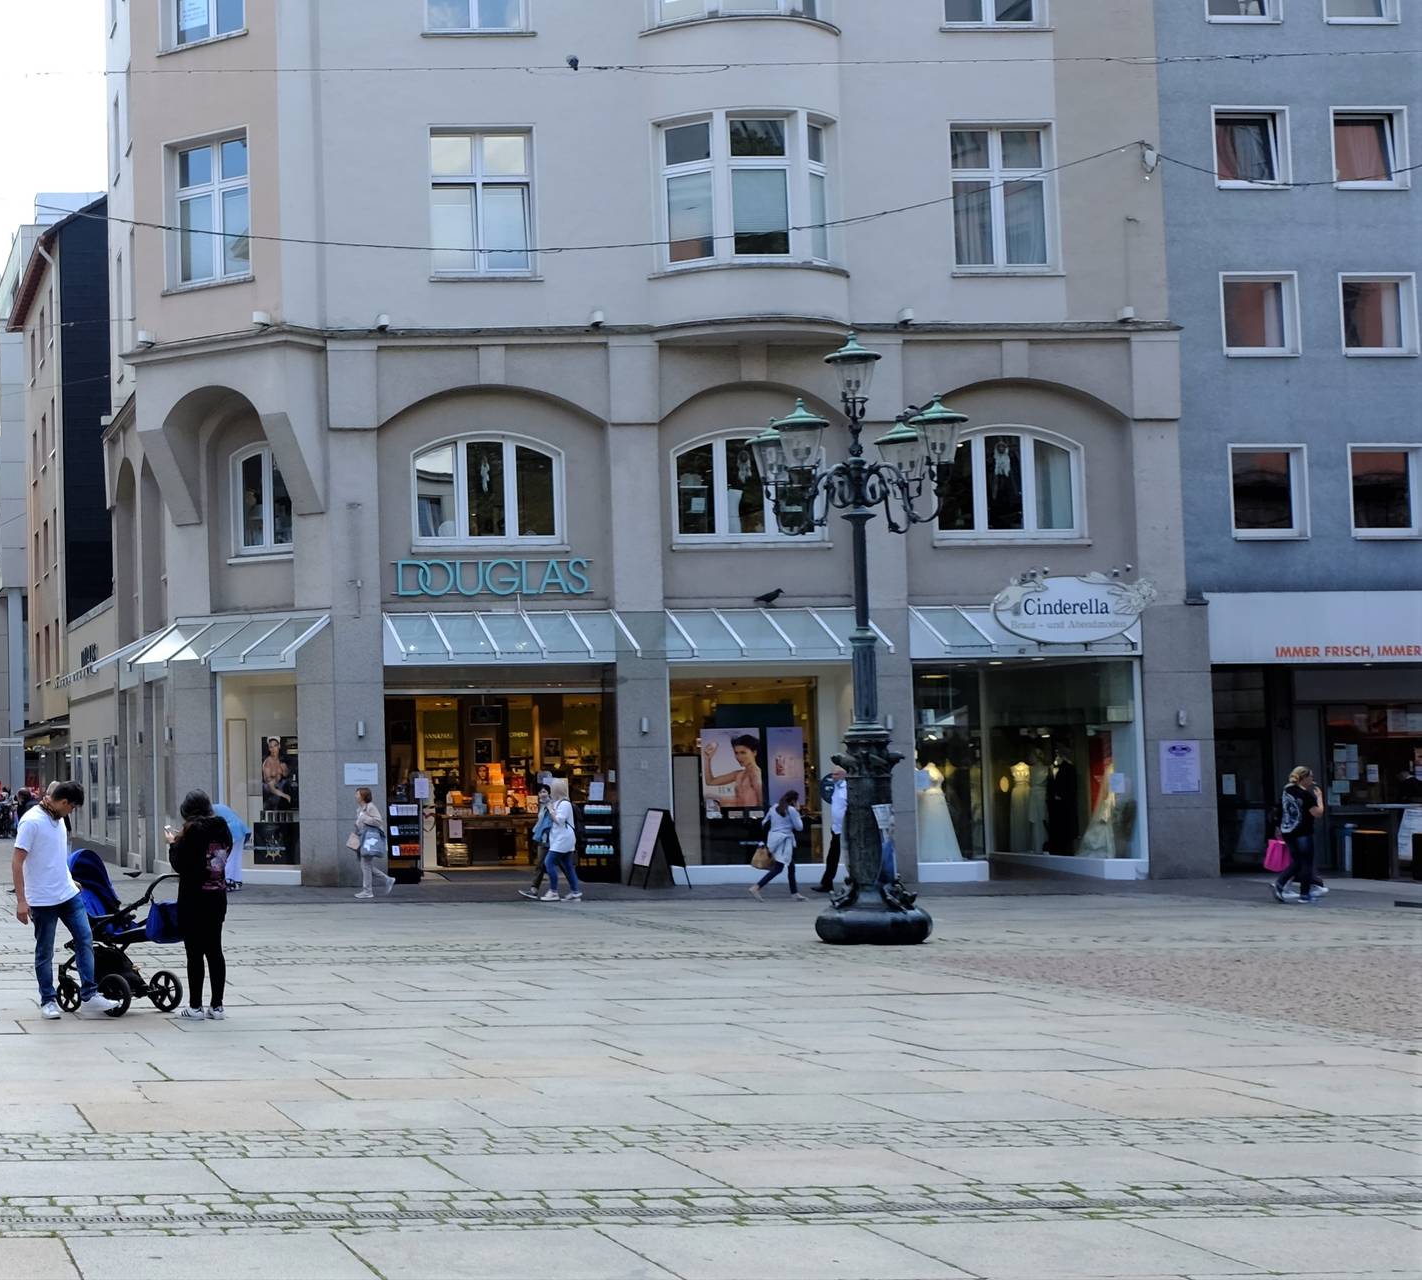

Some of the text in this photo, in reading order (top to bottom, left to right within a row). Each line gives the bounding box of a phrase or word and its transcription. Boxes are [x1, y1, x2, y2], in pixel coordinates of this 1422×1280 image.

[396, 557, 590, 597] DOUGLAS
[1023, 597, 1110, 616] Cinderella
[1275, 644, 1422, 658] IMMER FRISCH, IMMER
